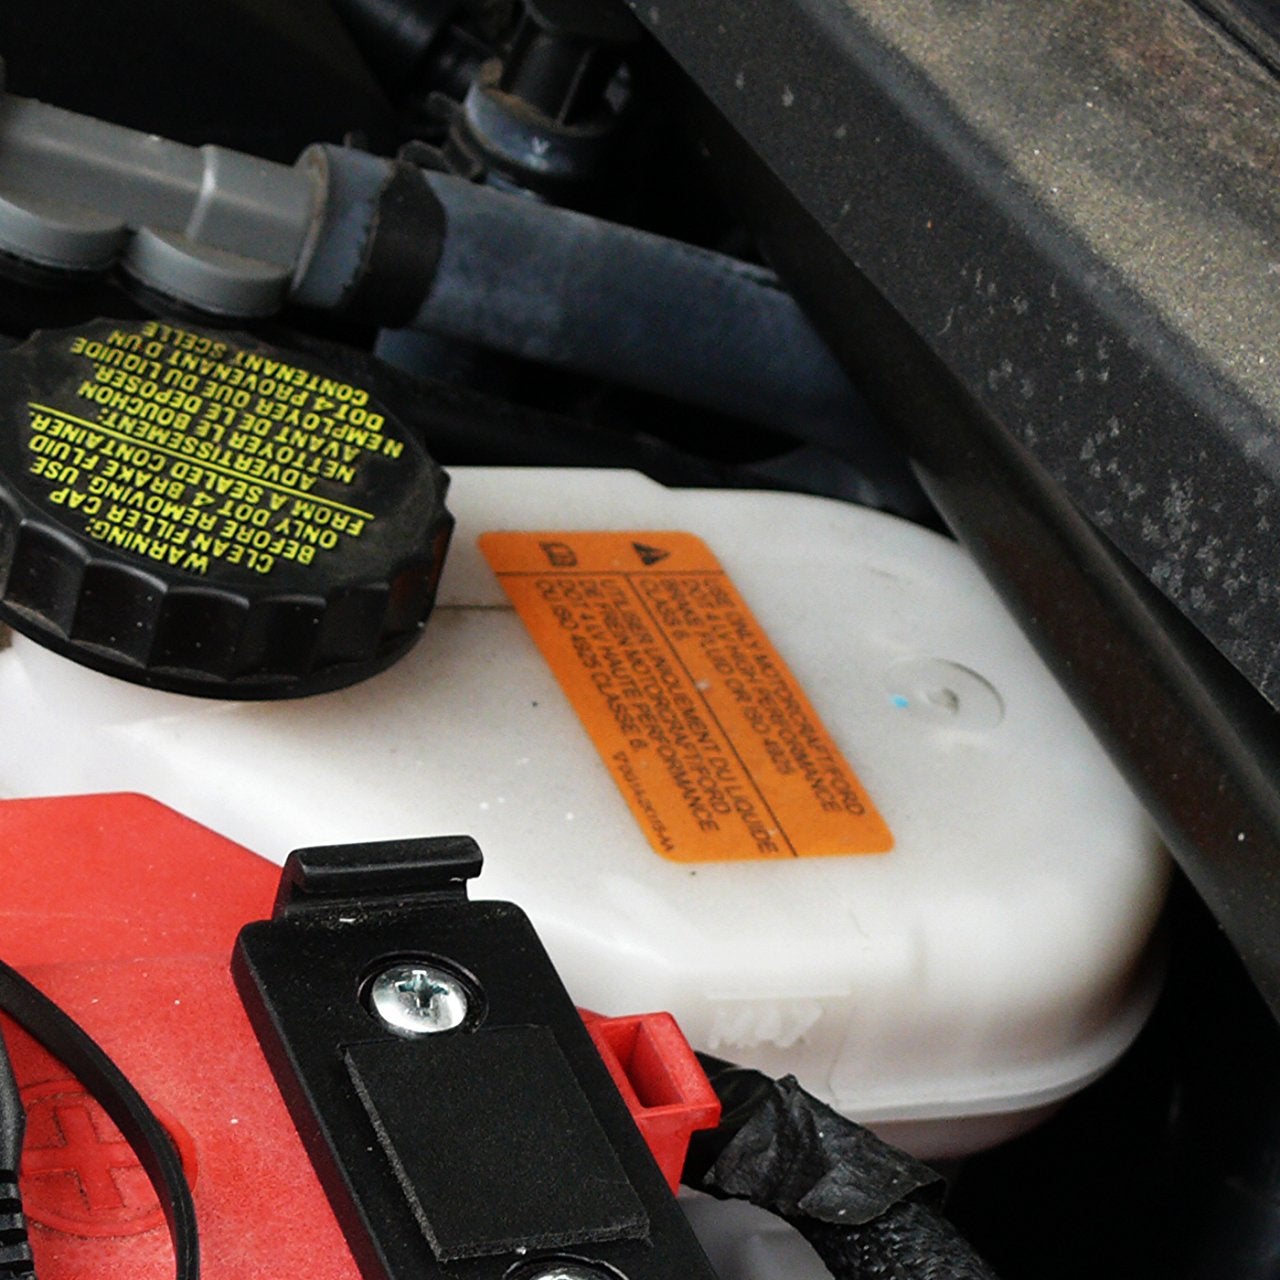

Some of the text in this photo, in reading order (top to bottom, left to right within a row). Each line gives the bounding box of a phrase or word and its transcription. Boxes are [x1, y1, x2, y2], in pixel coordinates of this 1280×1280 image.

[70, 337, 161, 379] LIQUIDE
[142, 322, 369, 406] CONTENANT SCELLE
[164, 368, 200, 391] DU
[168, 350, 307, 406] PROVENANT
[202, 379, 250, 408] QUE
[78, 380, 356, 482] NETTOYER LE BOUCHON
[92, 362, 360, 461] AVANT DE LE DEPOSER.
[314, 396, 335, 411] 4
[337, 404, 383, 431] DOT
[30, 411, 364, 537] FROM A SEALED CONTAINER.
[98, 408, 315, 490] ADVERTISSEMENT:
[29, 434, 337, 549] ONLY DOT 4 BRAKE FLUID
[30, 456, 315, 565] BEFORE REMOVING. USE
[49, 488, 273, 574] CLEAN FILLER CAP
[85, 518, 208, 574] WARNING:
[592, 672, 639, 734] CLASSE
[600, 647, 642, 698] HAUTE
[632, 704, 720, 832] PERFORMANCE
[756, 687, 841, 812] PERFORMANCE
[710, 757, 736, 783] DU
[727, 786, 779, 854] LIQUIDE
